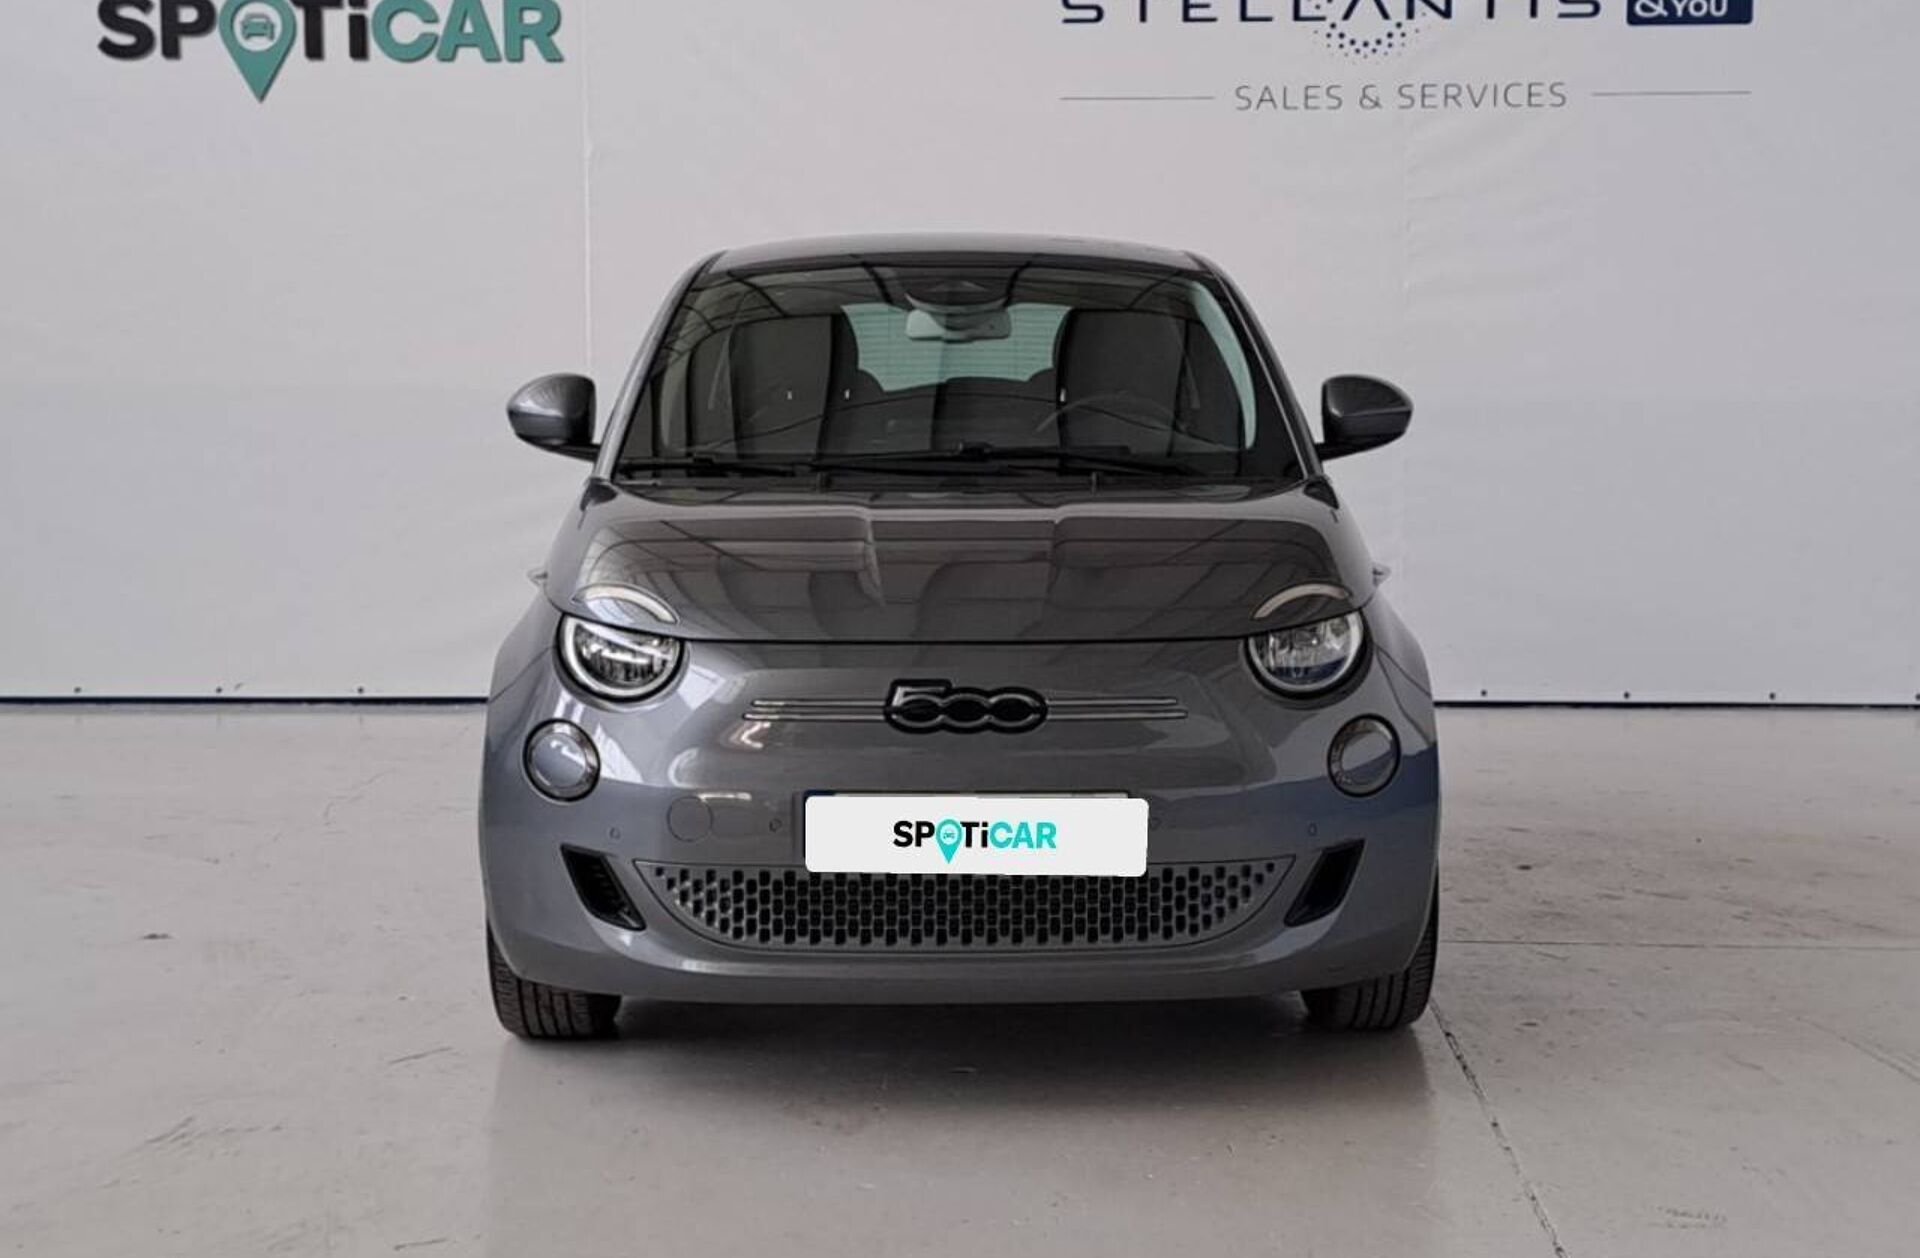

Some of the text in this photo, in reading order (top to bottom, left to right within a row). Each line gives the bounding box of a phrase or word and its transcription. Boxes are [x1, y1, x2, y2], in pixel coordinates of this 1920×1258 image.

[1234, 81, 1568, 111] SALES & SERVICES
[884, 679, 1049, 734] 500
